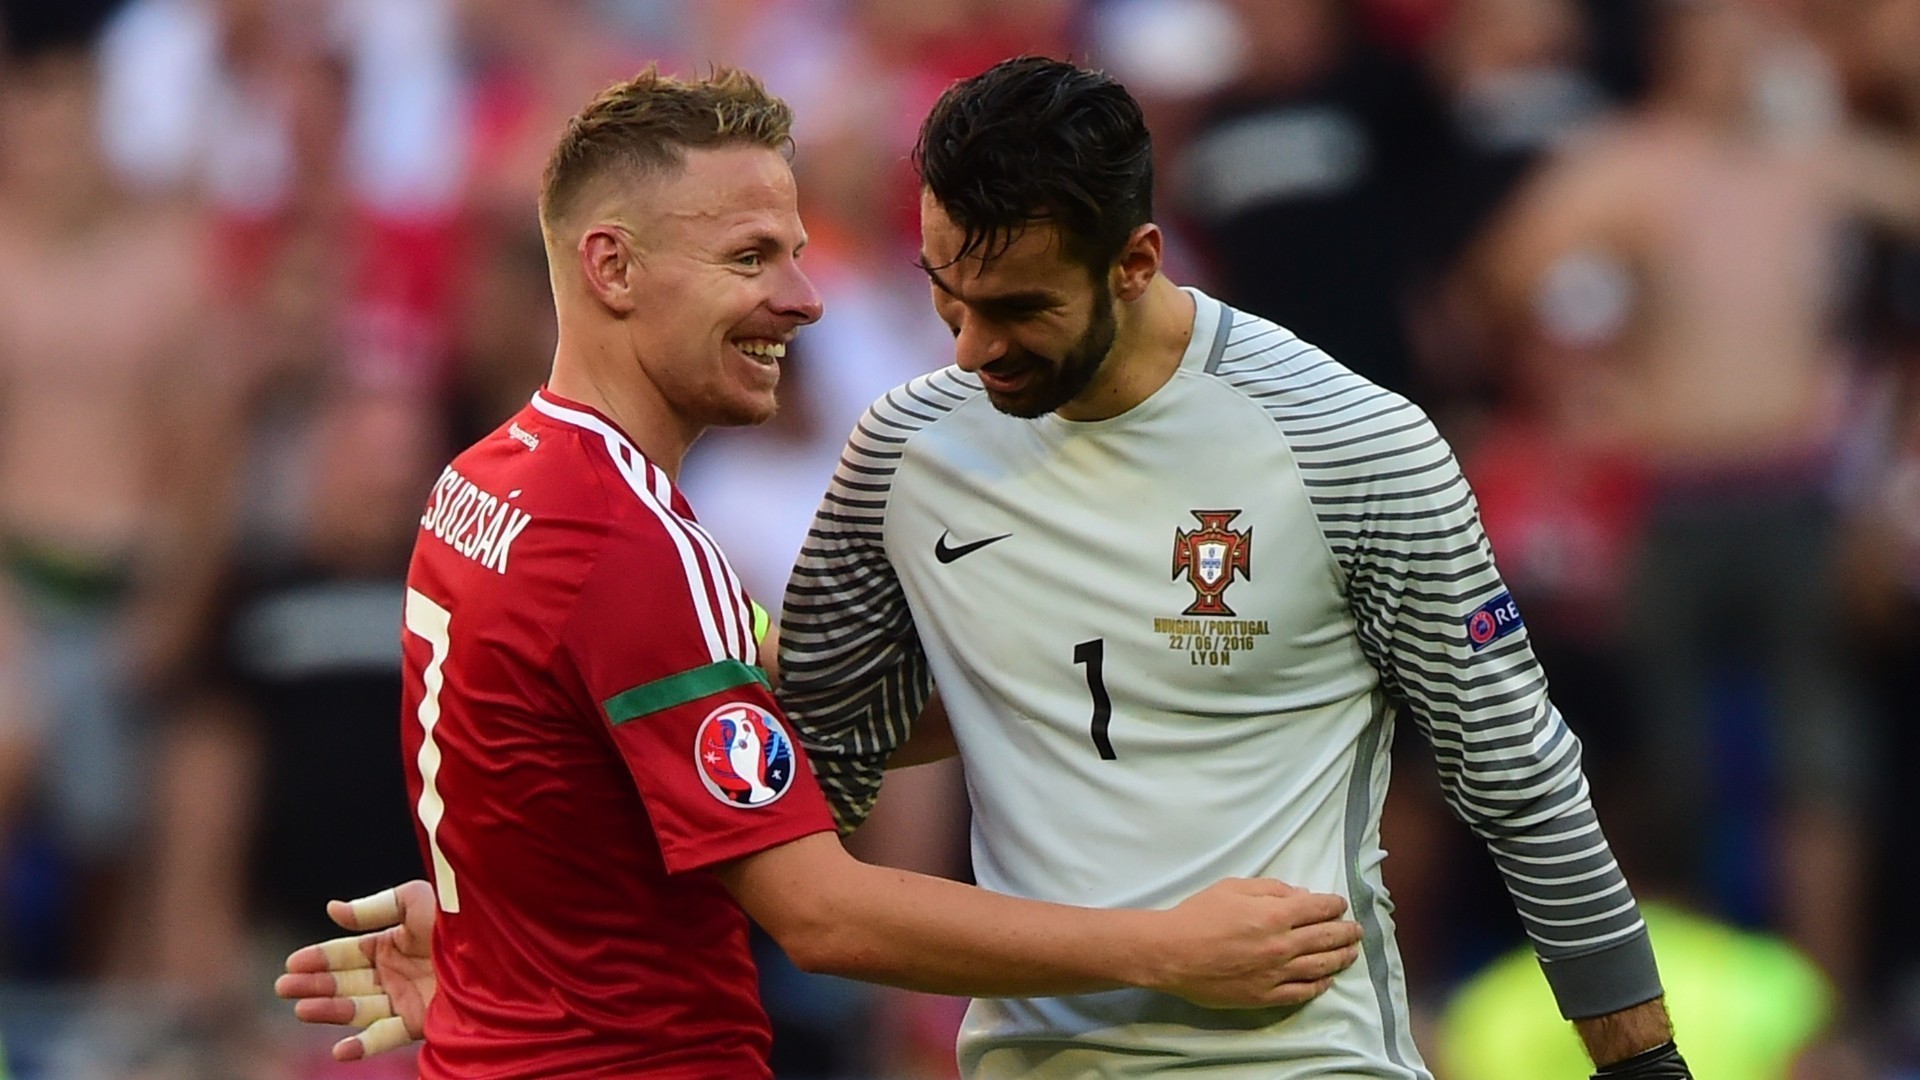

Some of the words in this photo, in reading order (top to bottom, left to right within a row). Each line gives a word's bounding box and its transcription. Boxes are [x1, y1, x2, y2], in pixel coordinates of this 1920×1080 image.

[1073, 638, 1117, 760] 1
[1191, 650, 1230, 666] LYON
[405, 586, 460, 913] 7
